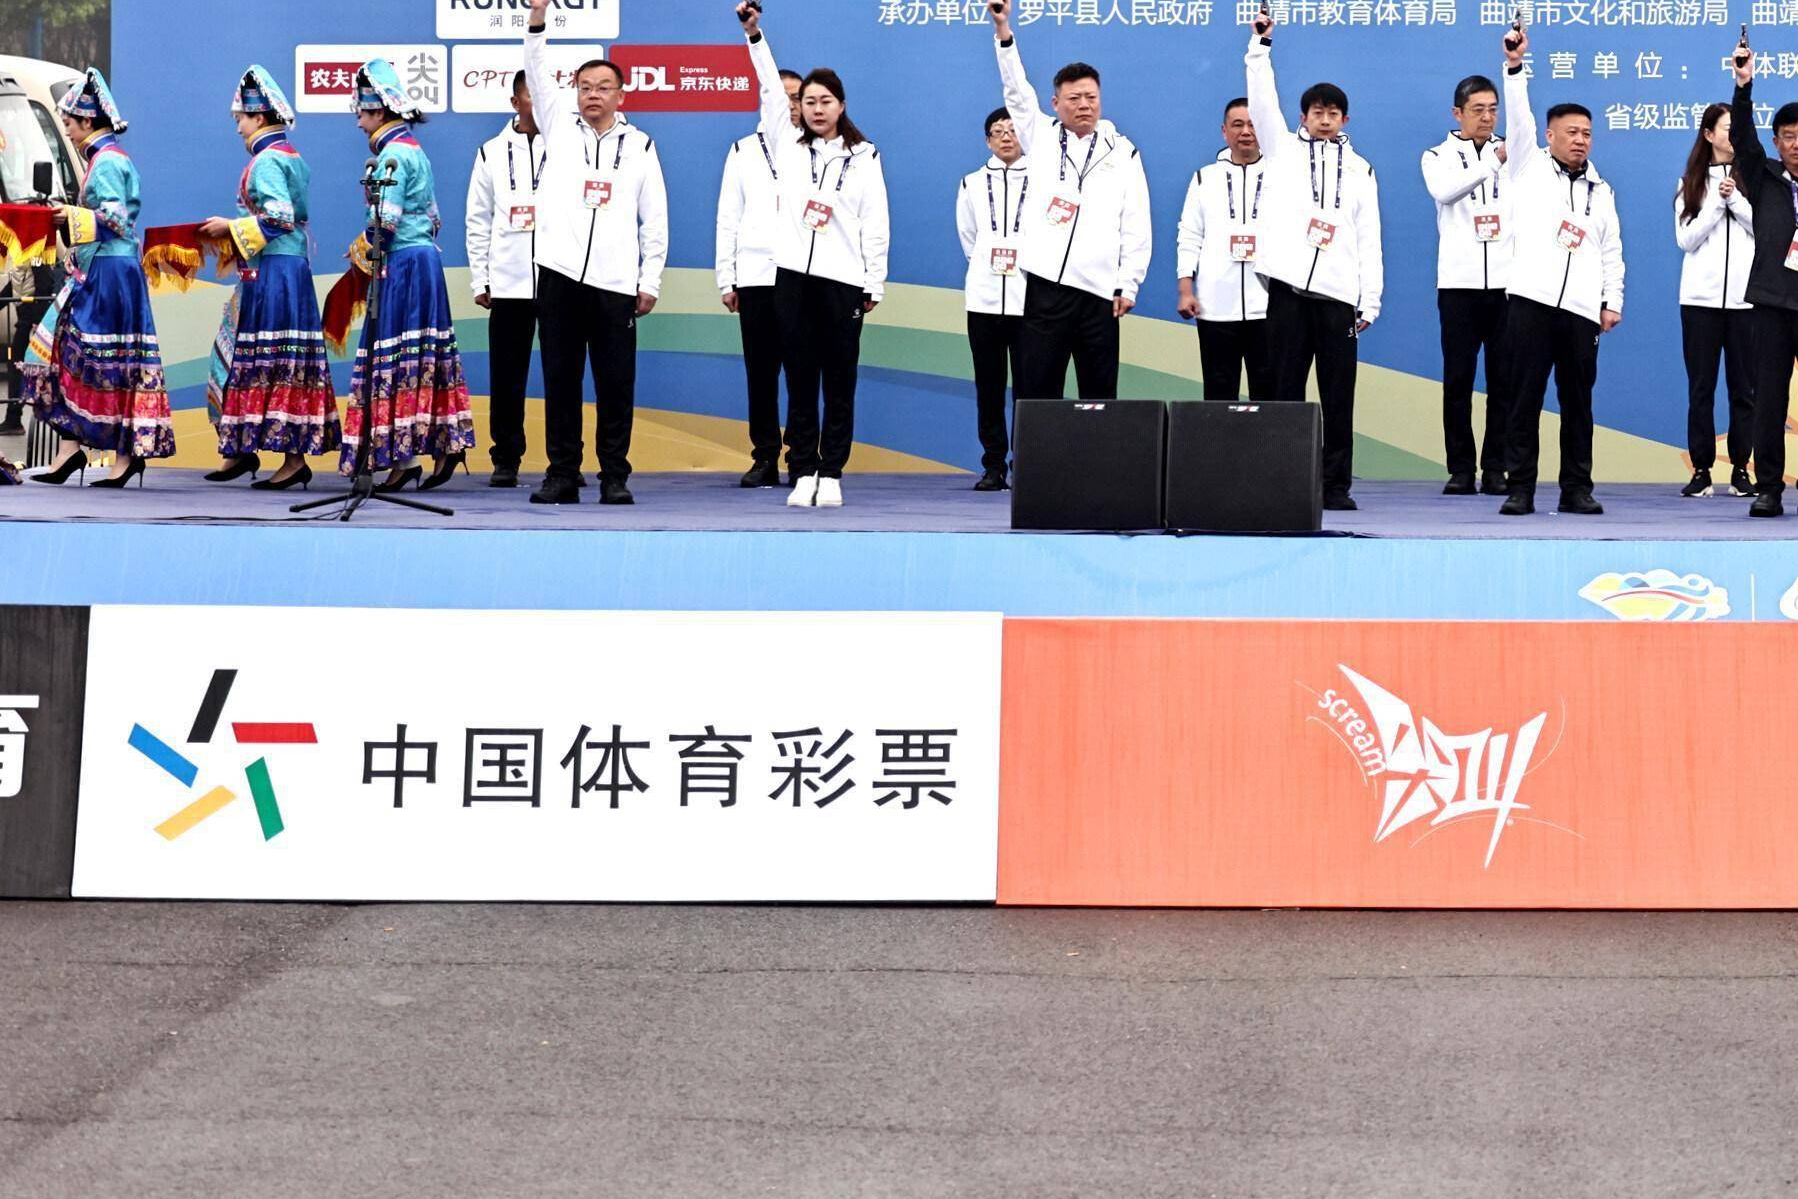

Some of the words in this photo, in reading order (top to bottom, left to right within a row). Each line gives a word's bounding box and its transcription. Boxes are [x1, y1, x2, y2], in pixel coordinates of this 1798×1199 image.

[489, 14, 567, 28] 润阳份
[621, 66, 675, 92] JDL
[680, 66, 709, 74] Express
[680, 76, 750, 92] 京东快递
[1317, 688, 1389, 777] scream
[361, 723, 960, 811] 中国体育彩票
